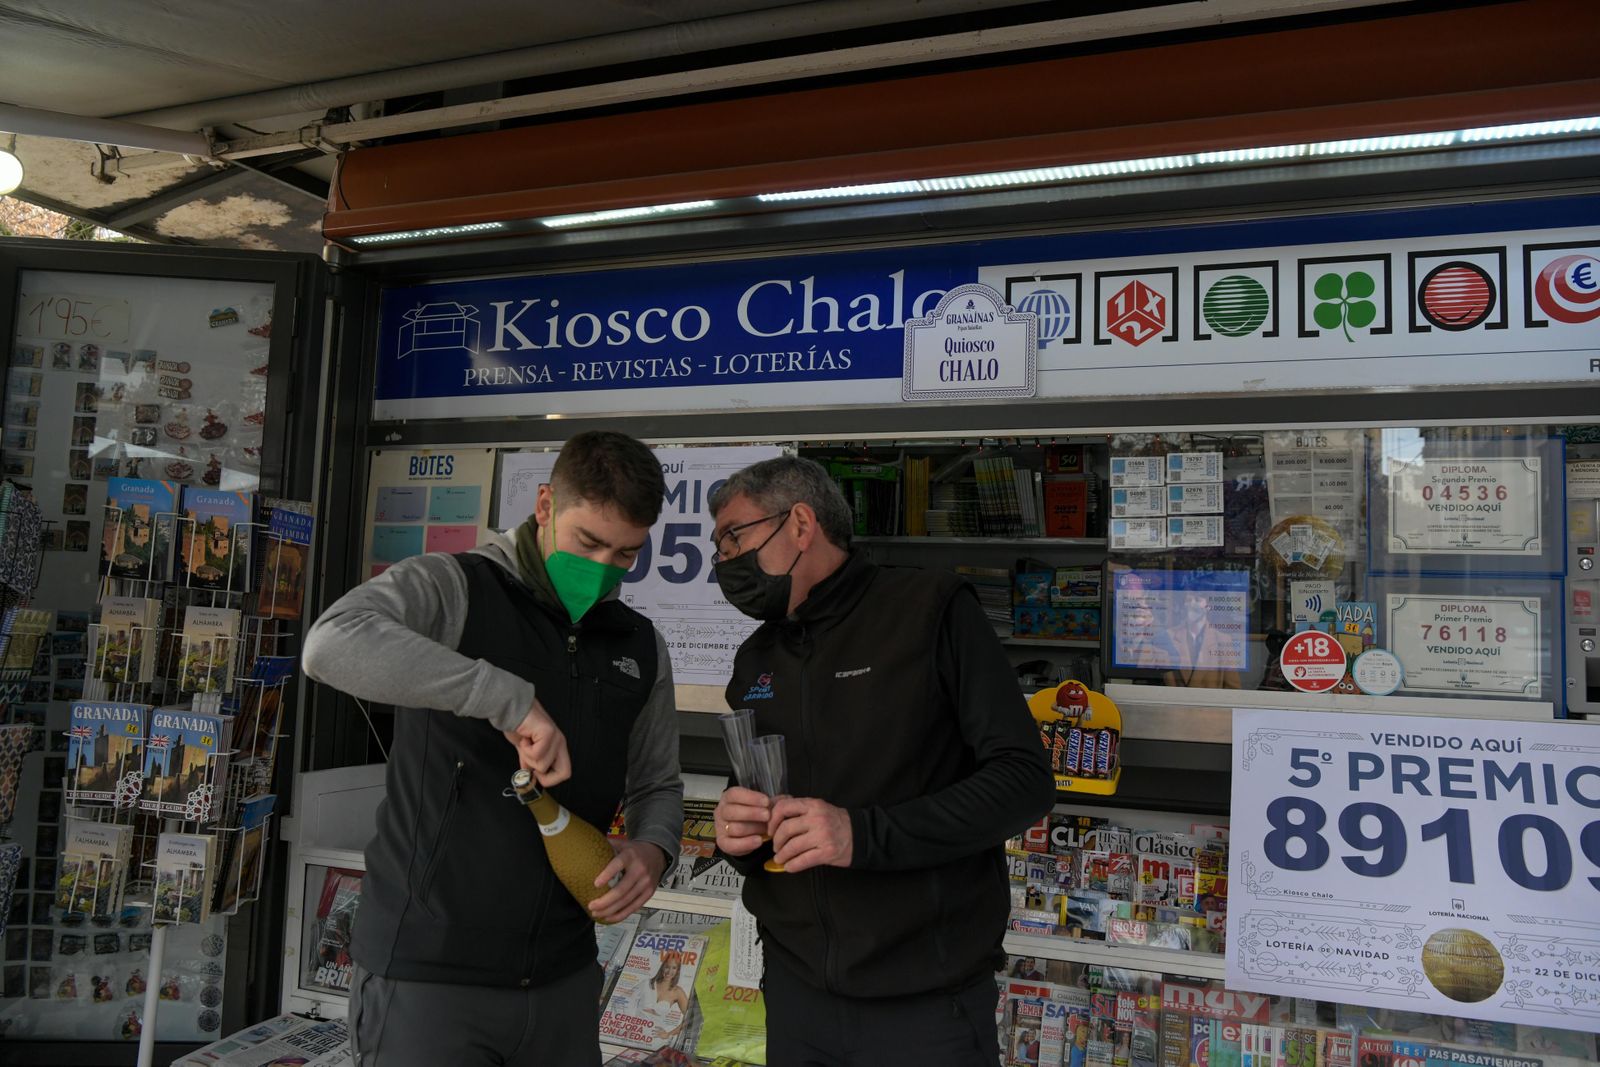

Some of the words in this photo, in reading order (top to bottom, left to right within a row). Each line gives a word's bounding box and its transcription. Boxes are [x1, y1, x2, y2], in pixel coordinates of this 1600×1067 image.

[487, 298, 711, 352] Kiosco
[946, 311, 994, 325] GRANAÍNAS
[945, 337, 995, 357] Quiosco
[463, 364, 554, 387] PRENSA
[571, 356, 692, 382] REVISTAS
[713, 345, 852, 376] LOTERÍAS
[940, 358, 999, 382] CHALO
[1296, 436, 1328, 448] BOTES
[1441, 465, 1487, 474] DIPLOMA
[1431, 476, 1466, 485] Segundo
[1468, 475, 1497, 483] Premio
[121, 483, 155, 494] Granada
[196, 495, 235, 507] Granada
[1428, 503, 1474, 512] VENDIDO
[1475, 503, 1502, 513] AQUÍ
[273, 511, 312, 528] GRANADA
[1440, 604, 1487, 613] DIPLOMA
[1434, 614, 1461, 622] Primer
[1464, 615, 1493, 624] Premio
[1294, 637, 1330, 657] +18
[1427, 645, 1473, 654] VENDIDO
[1475, 647, 1501, 656] AQUÍ
[73, 705, 139, 722] GRANADA
[153, 714, 216, 734] GRANADA
[1370, 732, 1463, 750] VENDIDO
[1470, 737, 1523, 754] AQUÍ
[1287, 748, 1334, 788] 5º
[1135, 836, 1200, 858] Clásico
[704, 874, 740, 889] TELVA
[1283, 888, 1310, 897] Kiosco
[1312, 890, 1335, 899] Chalo
[659, 911, 695, 925] TELVA
[1428, 910, 1456, 918] LOTERÍA
[1456, 913, 1490, 922] NACIONAL
[635, 935, 686, 952] SABER
[1265, 939, 1314, 952] LOTERÍA
[1335, 947, 1390, 961] NAVIDAD
[325, 960, 337, 970] UN
[1534, 967, 1550, 977] 22
[1553, 969, 1571, 979] DE
[723, 986, 760, 1003] 2021
[1163, 983, 1268, 1019] muy
[604, 1011, 613, 1019] EL
[614, 1013, 655, 1028] CEREBRO
[610, 1020, 644, 1034] MEJORA
[598, 1026, 616, 1035] CON
[616, 1028, 628, 1038] LA
[629, 1032, 653, 1043] EDAD
[1429, 1048, 1449, 1059] PAS
